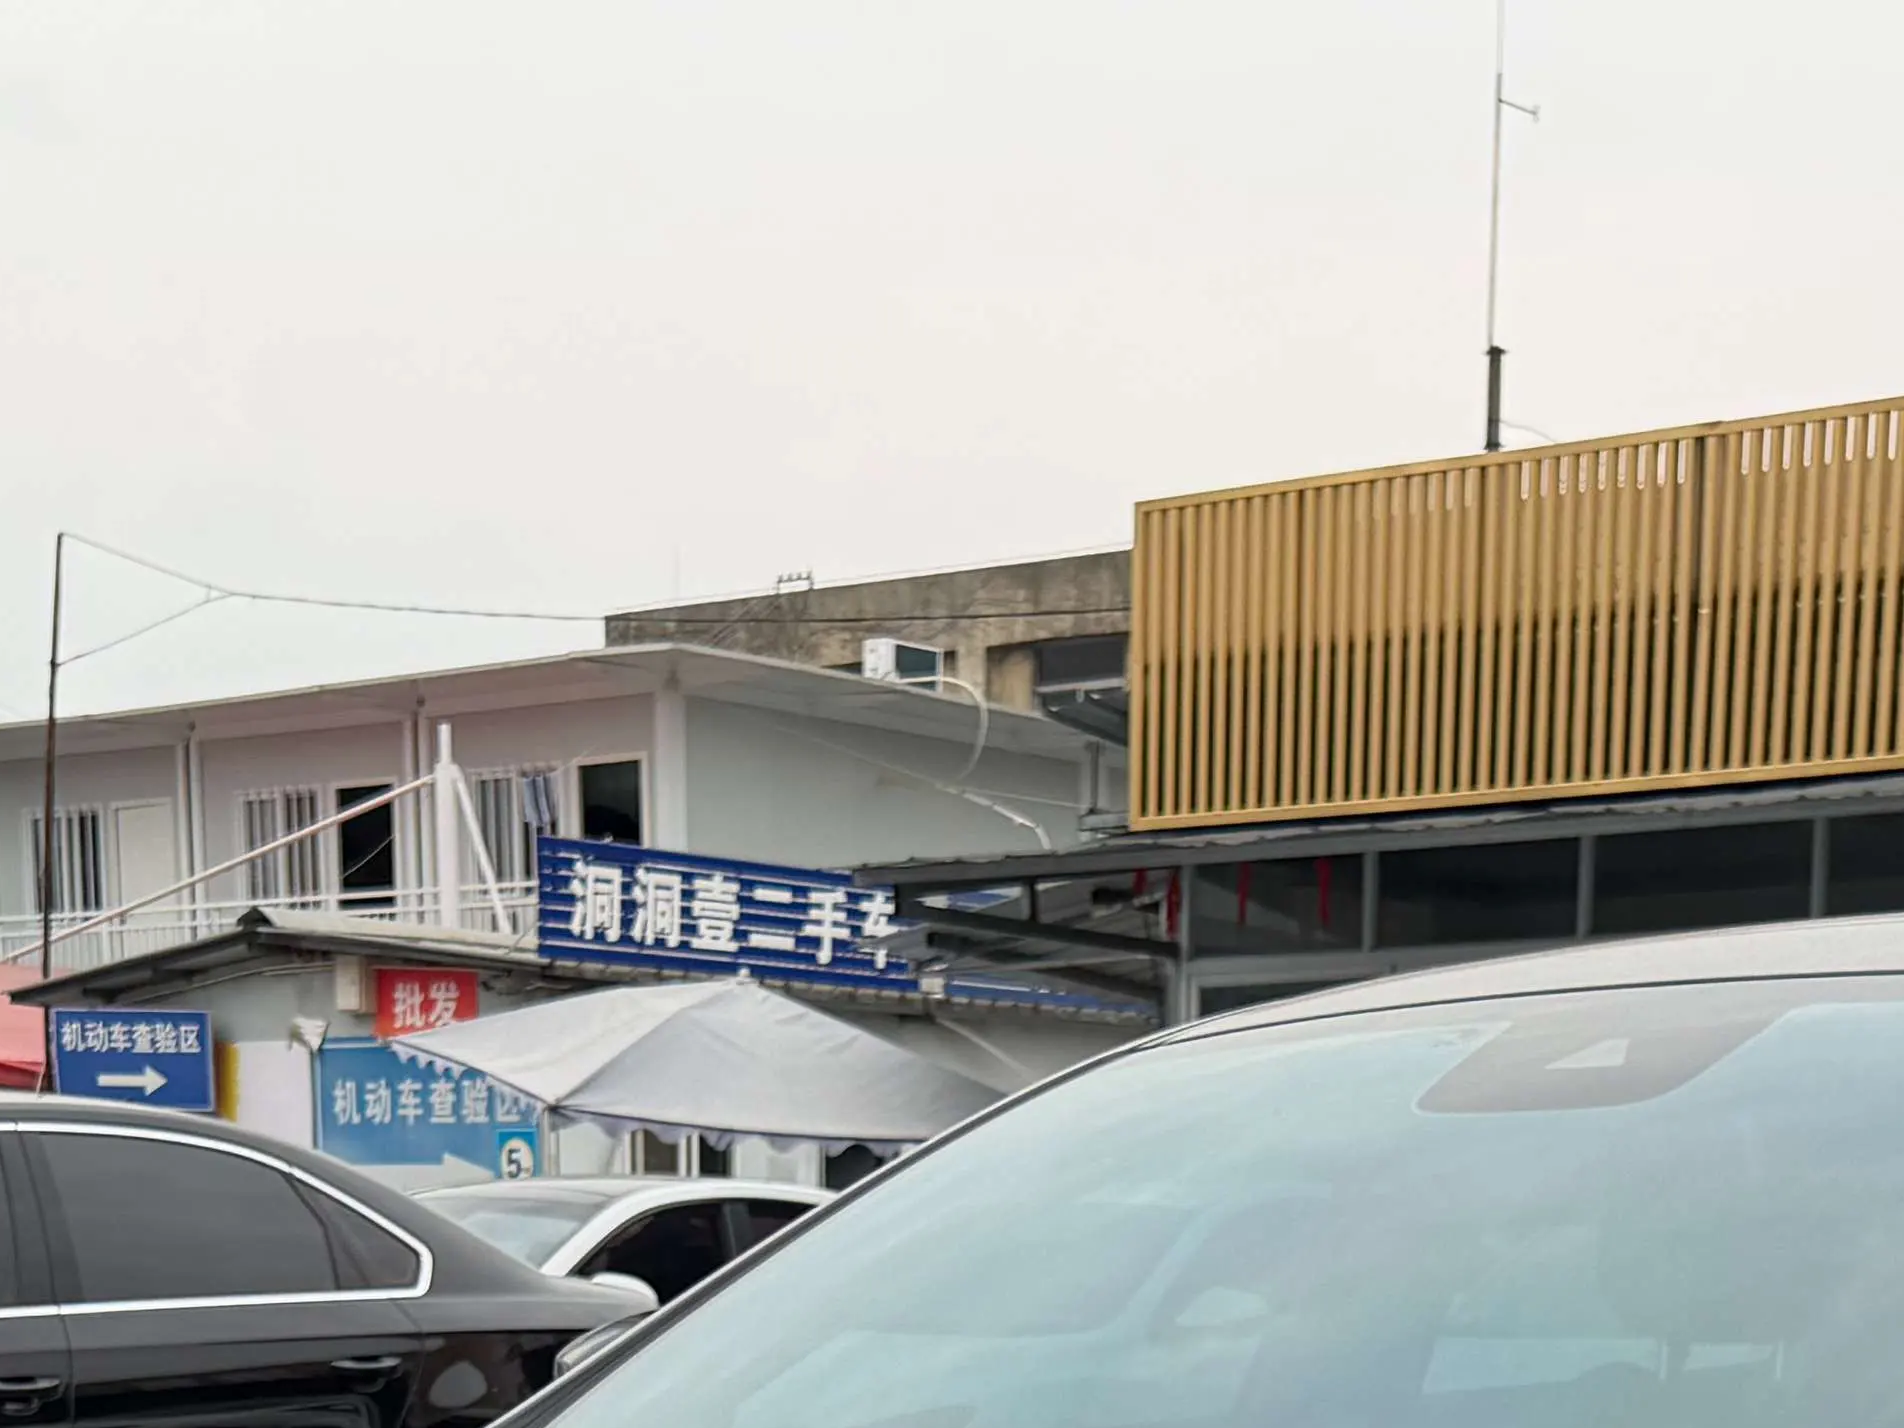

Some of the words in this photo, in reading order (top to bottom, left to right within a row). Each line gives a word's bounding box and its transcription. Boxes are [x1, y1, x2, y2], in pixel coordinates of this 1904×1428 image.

[392, 981, 460, 1027] 批发
[61, 1020, 201, 1053] 机动车查验区
